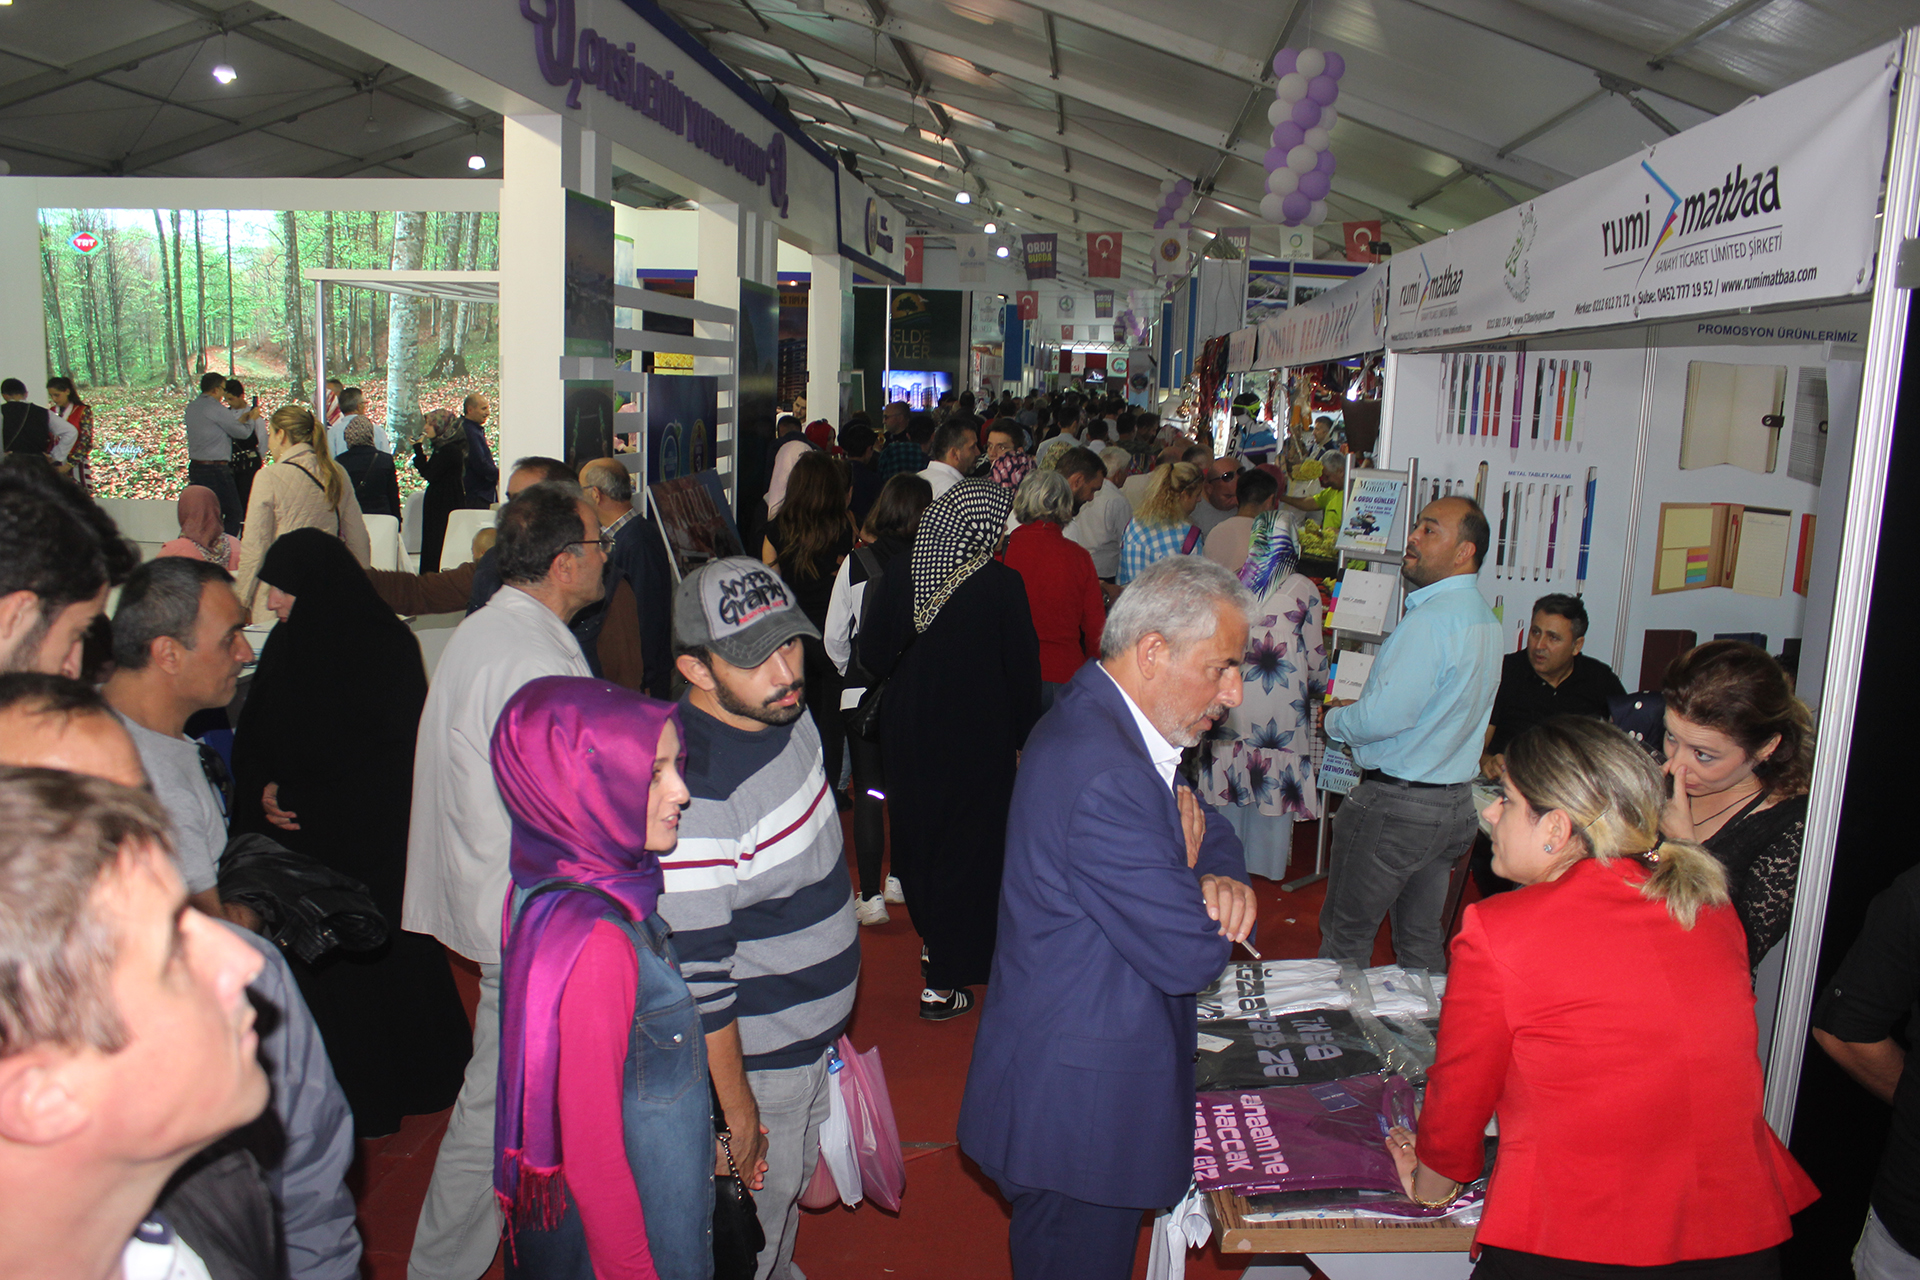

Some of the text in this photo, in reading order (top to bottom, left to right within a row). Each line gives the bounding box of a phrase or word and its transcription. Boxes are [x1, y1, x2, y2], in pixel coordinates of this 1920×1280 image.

[1602, 194, 1650, 258] rumi
[1679, 163, 1781, 237] matbaa
[75, 238, 96, 247] TRT
[1026, 240, 1053, 253] ORDU
[1679, 248, 1710, 269] TİCARET
[1711, 242, 1747, 263] LİMİTED
[1749, 231, 1783, 261] ŞİRKETİ
[1027, 252, 1052, 263] BURDA
[1428, 263, 1464, 301] matbaa
[1657, 285, 1675, 302] 0452
[1676, 283, 1690, 299] 777
[1692, 281, 1702, 297] 19
[1703, 280, 1713, 296] 52
[1721, 266, 1818, 294] www.rumimatbaa.com
[893, 328, 931, 344] ELDE
[1697, 323, 1859, 343] PROMOSYON ÜRÜNLERİMİZ
[892, 344, 931, 360] VLER
